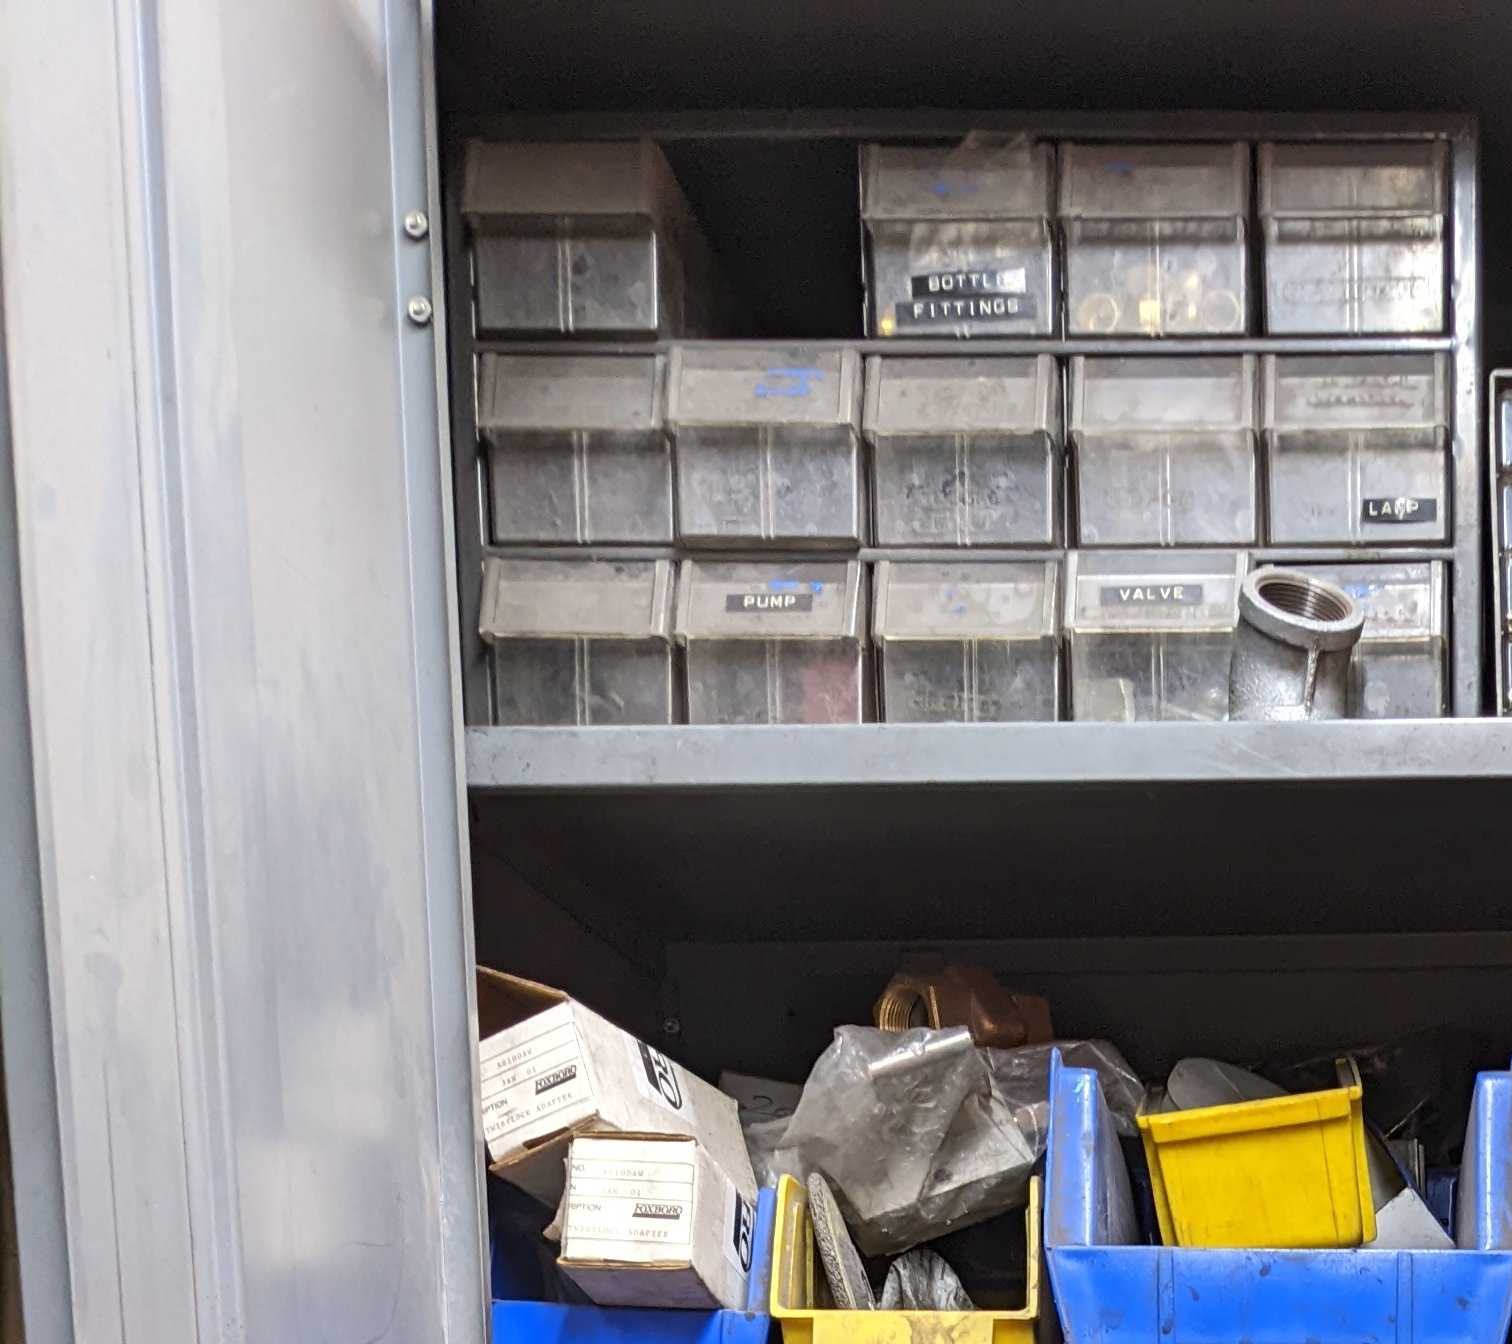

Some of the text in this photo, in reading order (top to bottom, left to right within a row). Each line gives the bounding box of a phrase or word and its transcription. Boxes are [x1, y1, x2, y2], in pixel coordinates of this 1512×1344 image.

[914, 298, 1018, 319] FITTINGS
[1120, 586, 1184, 600] VALVE
[744, 595, 795, 608] PUMP
